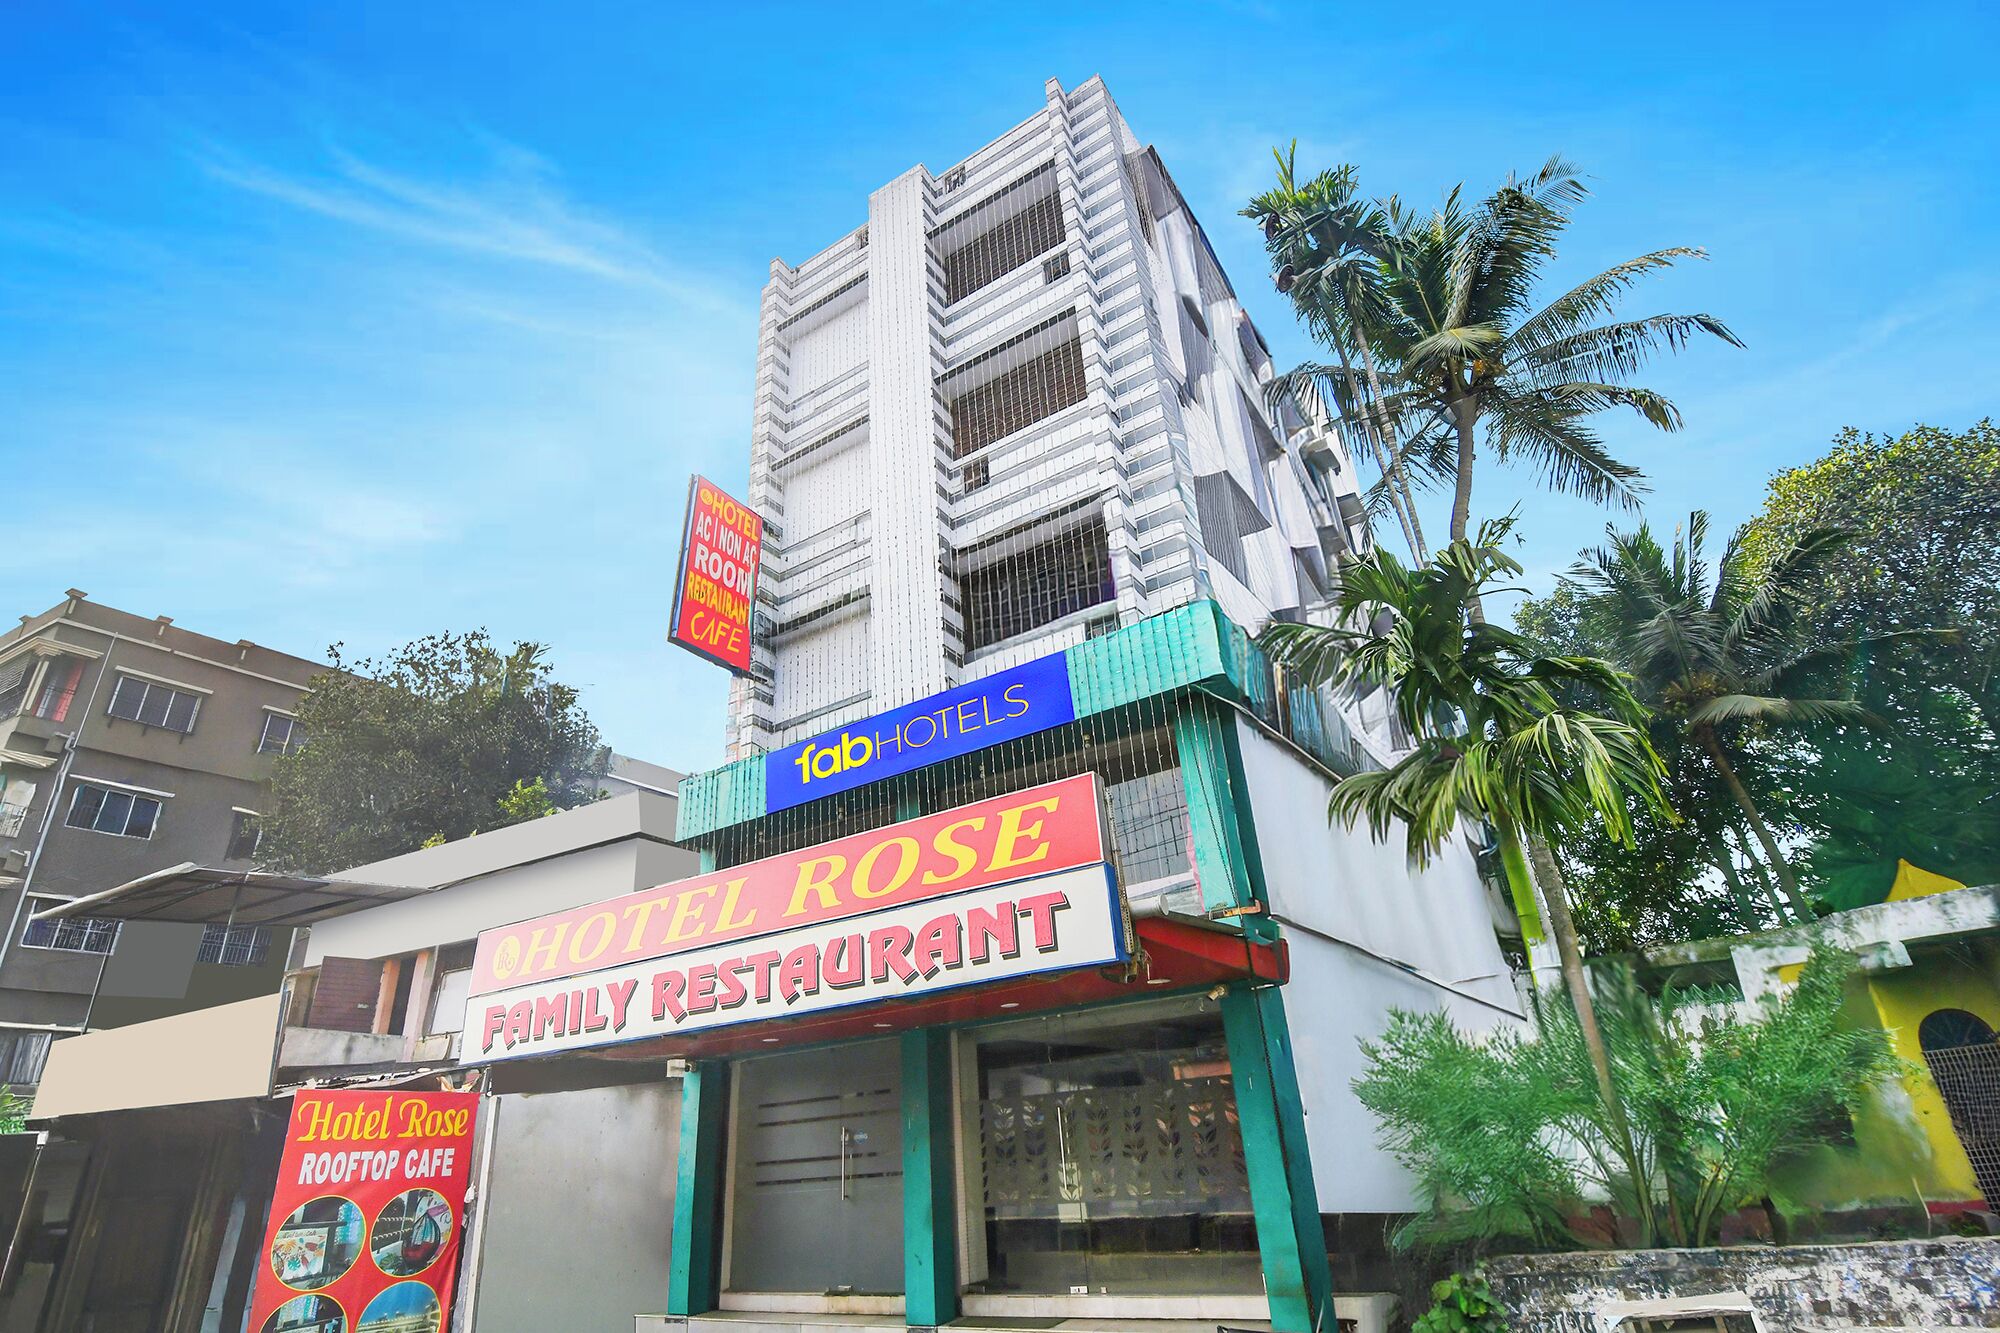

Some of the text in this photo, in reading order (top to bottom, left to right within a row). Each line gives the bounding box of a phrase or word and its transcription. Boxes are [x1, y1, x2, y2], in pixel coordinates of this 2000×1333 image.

[696, 512, 712, 542] AC
[718, 524, 742, 561] NON
[742, 540, 757, 570] AC
[712, 492, 758, 541] HOTEL
[687, 571, 750, 628] RESTAURAN
[694, 541, 752, 602] ROOM
[691, 610, 744, 653] CAFE
[515, 796, 1060, 977] HOTEL ROSE
[482, 890, 1072, 1054] FAMILY RESTAURANT
[296, 1095, 470, 1142] Hotel Rose
[298, 1148, 455, 1185] ROOFTOP CAFE
